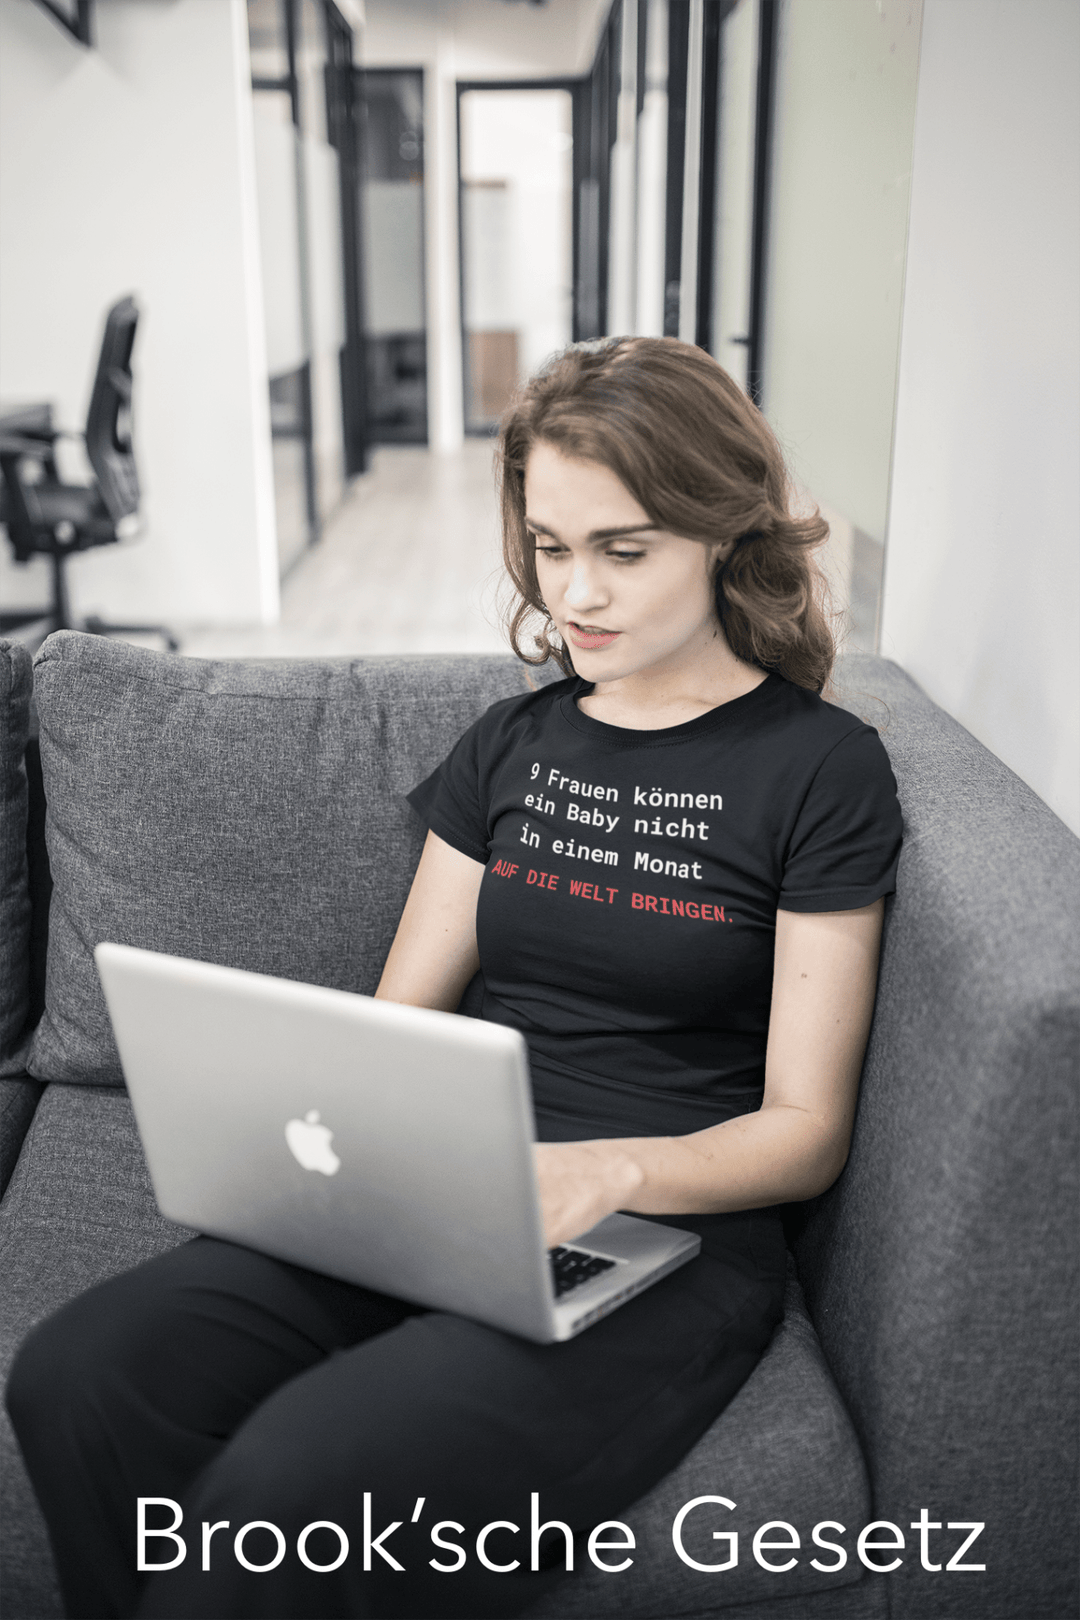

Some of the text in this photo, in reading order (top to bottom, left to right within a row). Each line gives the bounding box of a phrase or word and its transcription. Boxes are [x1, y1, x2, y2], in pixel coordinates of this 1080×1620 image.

[530, 763, 722, 810] 9 Frauen können
[525, 793, 709, 840] ein Baby nicht
[520, 823, 702, 879] in einem Monat
[491, 859, 732, 922] AUF DIE WELT BRINGEN.
